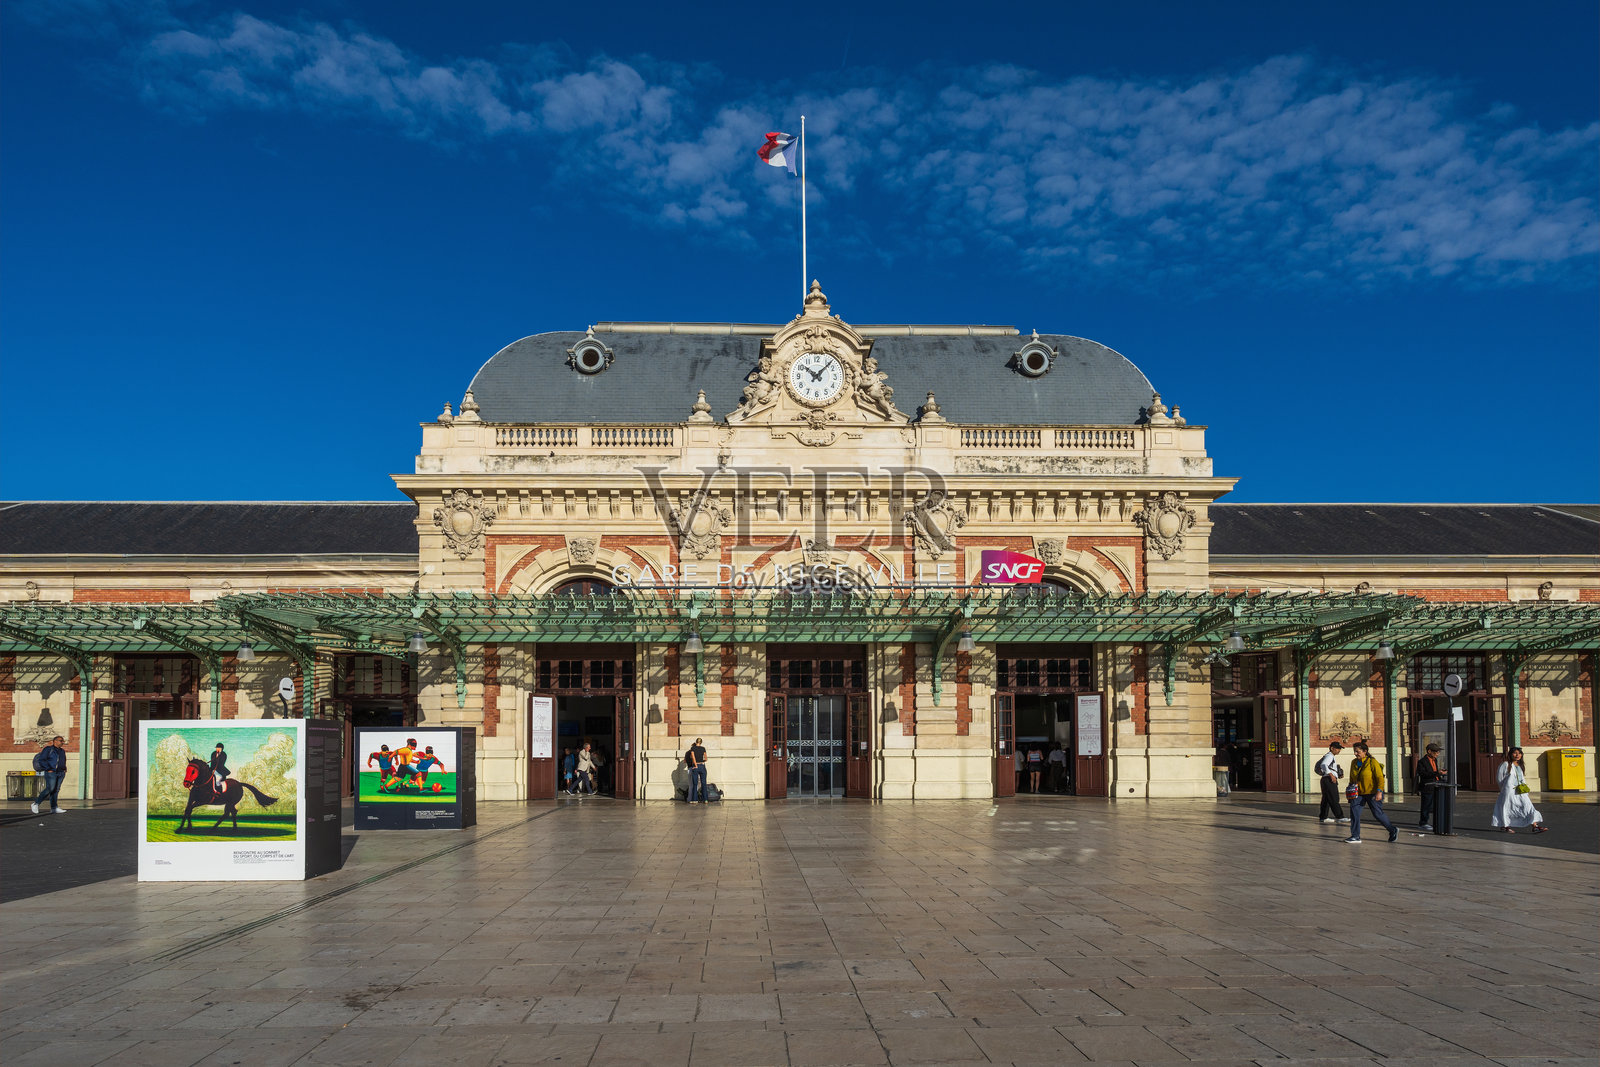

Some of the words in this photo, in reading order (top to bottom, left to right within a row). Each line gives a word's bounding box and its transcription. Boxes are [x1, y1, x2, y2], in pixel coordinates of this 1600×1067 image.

[611, 564, 697, 584] GARE
[717, 564, 754, 584] DE
[774, 564, 848, 584] NICE
[867, 564, 950, 584] VILLE
[985, 563, 1041, 579] SNCF
